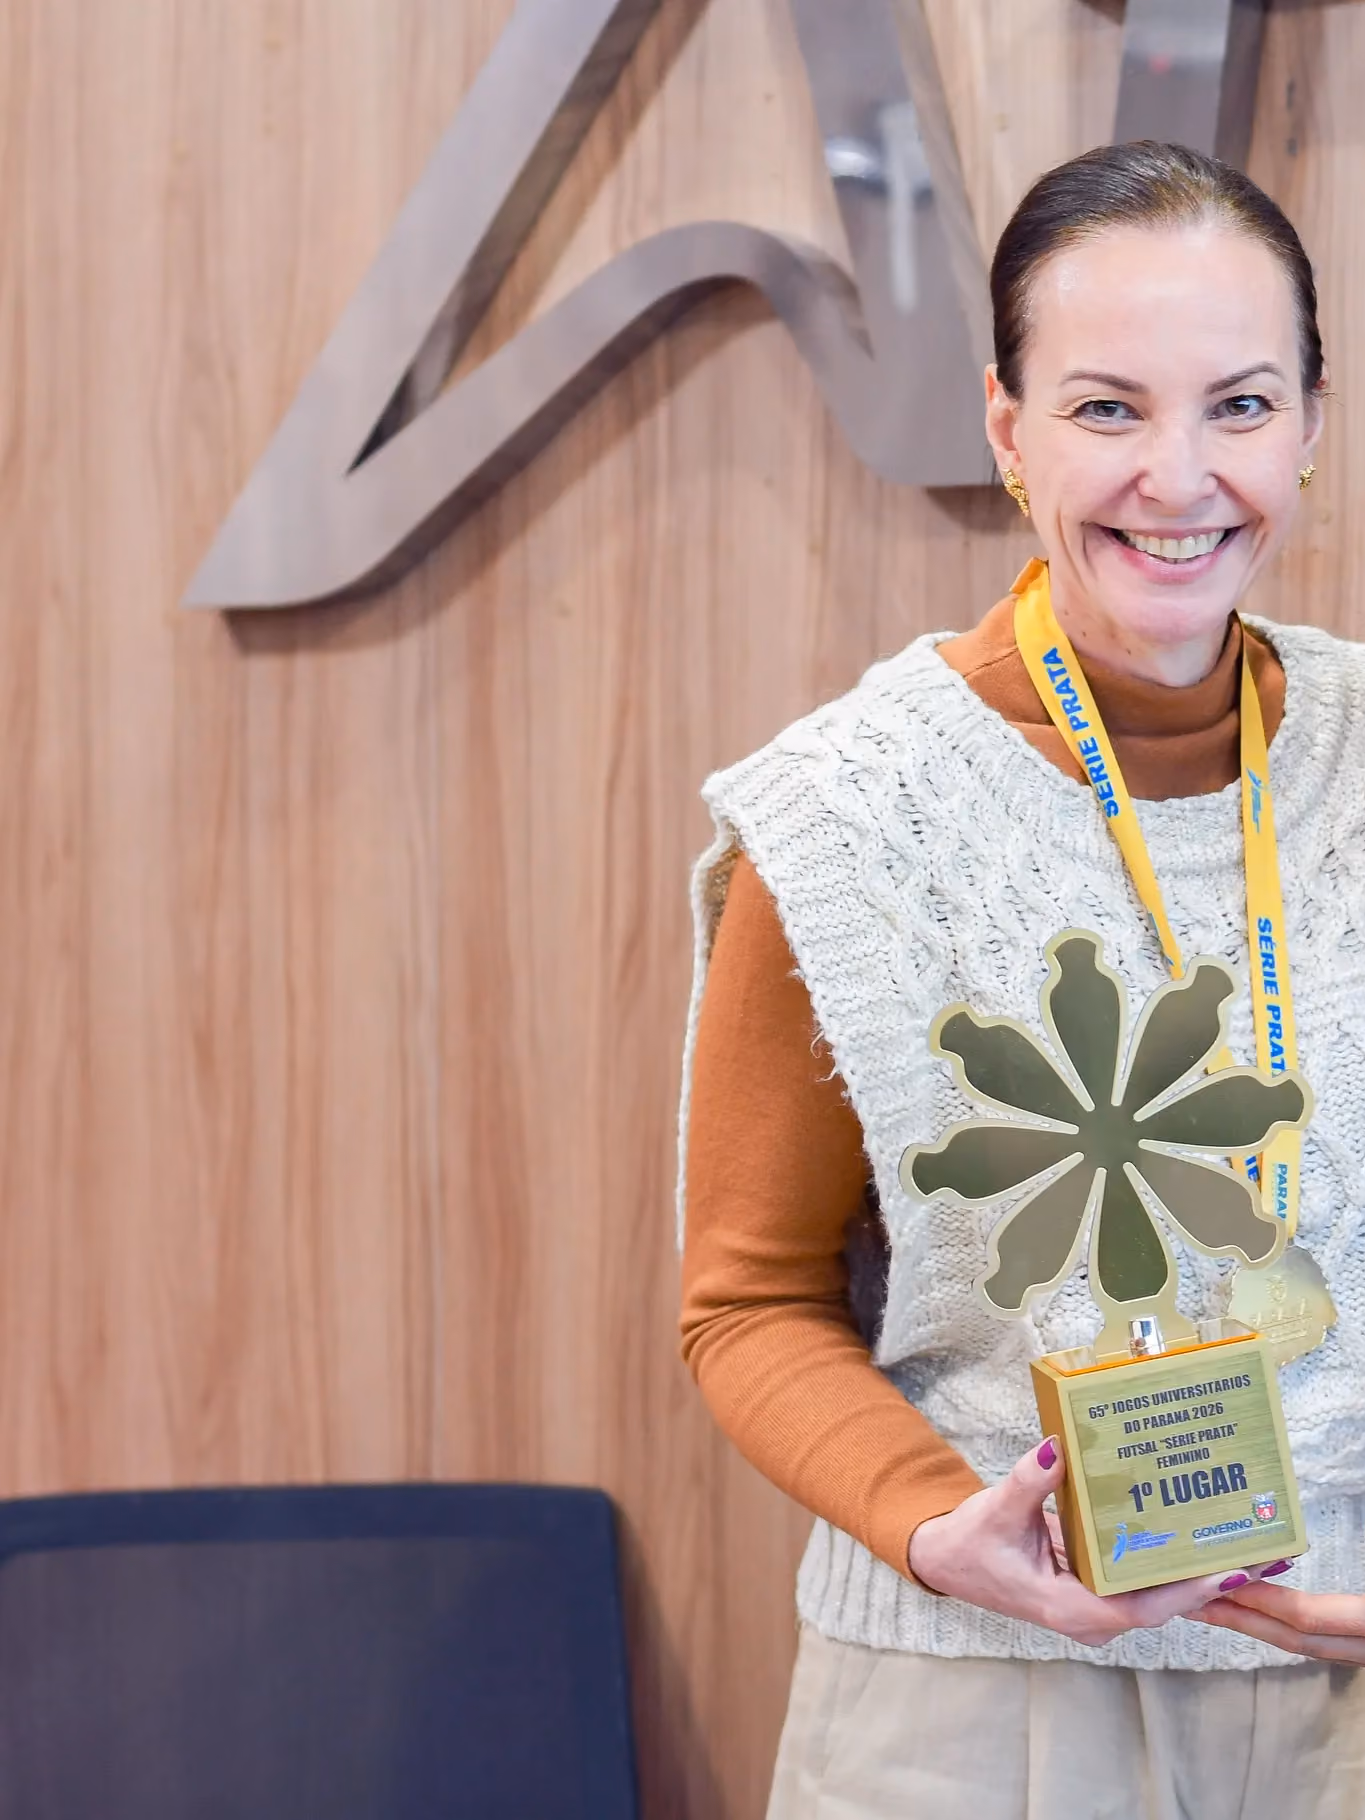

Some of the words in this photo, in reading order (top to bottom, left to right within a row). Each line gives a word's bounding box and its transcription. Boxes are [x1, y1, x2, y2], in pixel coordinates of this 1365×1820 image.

[1042, 647, 1089, 732] PRATA
[1257, 917, 1279, 996] SÉRIE
[1266, 1004, 1286, 1072] PRAT
[1113, 1395, 1150, 1414] JOGOS
[1124, 1419, 1140, 1434] DO
[1192, 1402, 1224, 1420] 2026
[1117, 1440, 1158, 1459] FUTSAL
[1156, 1447, 1210, 1469] FEMININO
[1159, 1462, 1248, 1507] LUGAR
[1192, 1518, 1253, 1539] GOVERNO
